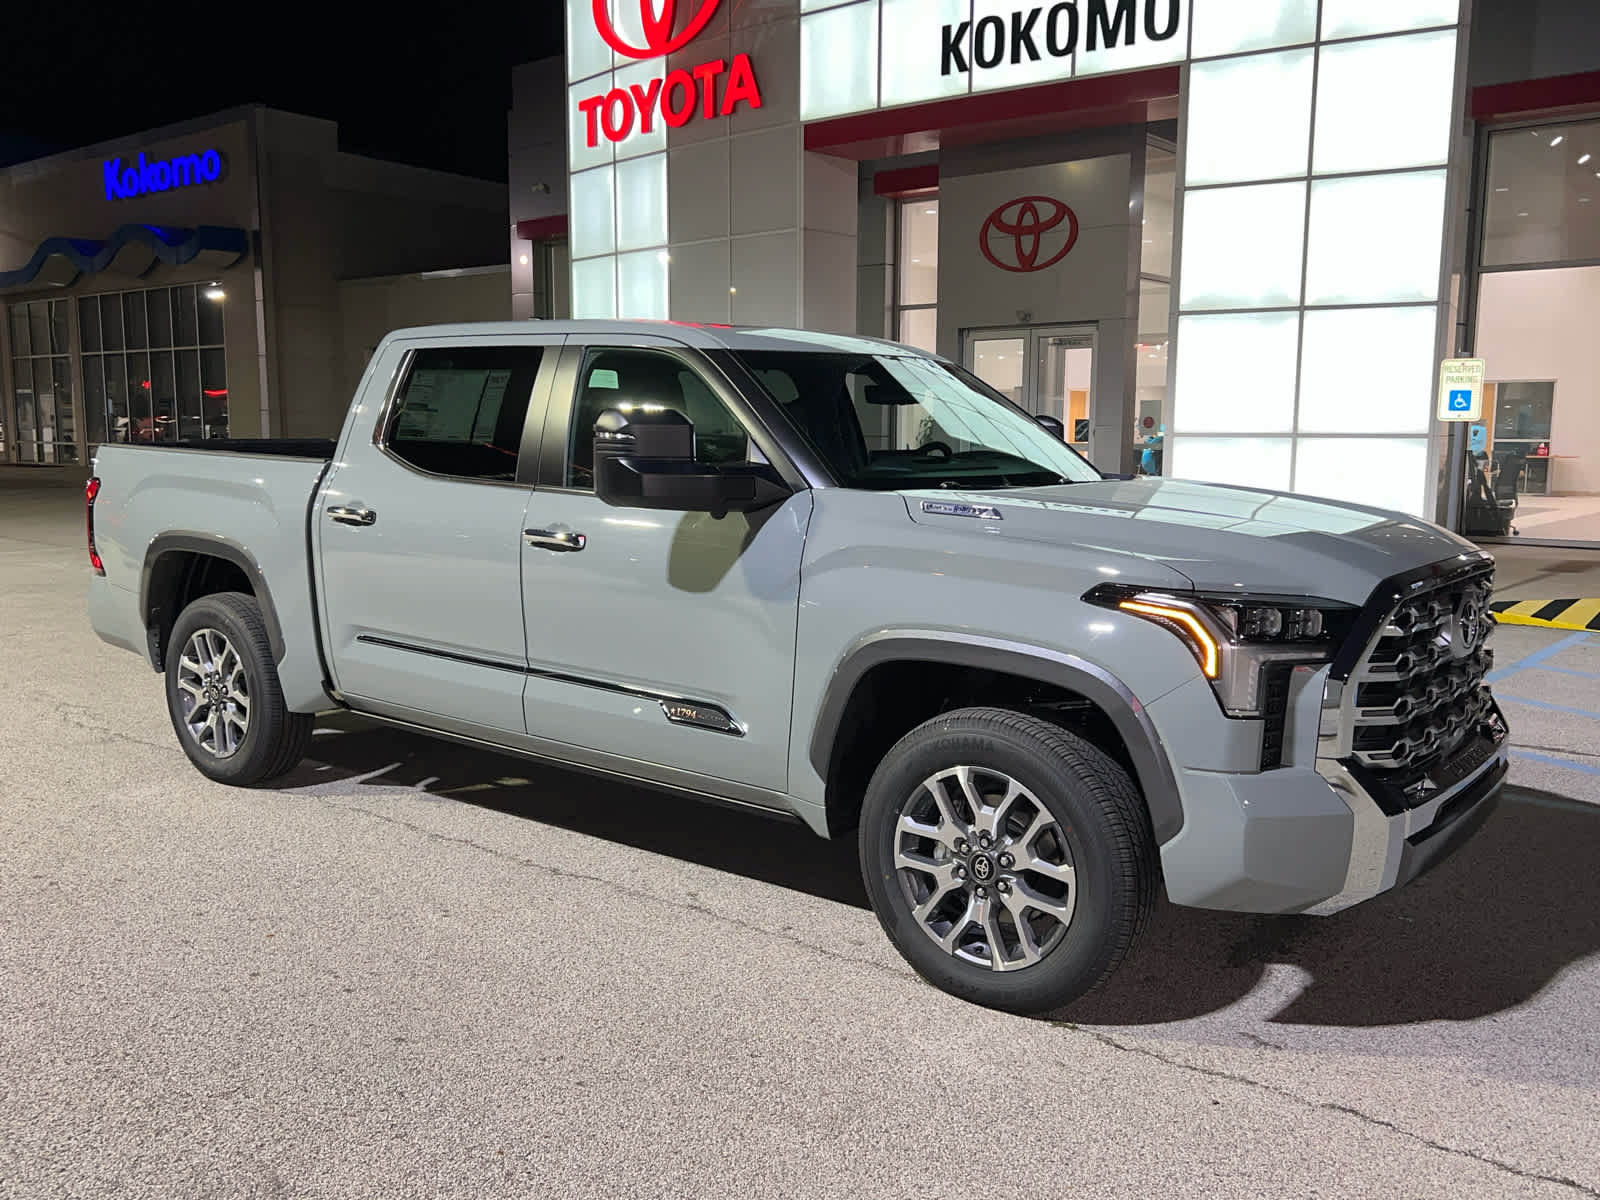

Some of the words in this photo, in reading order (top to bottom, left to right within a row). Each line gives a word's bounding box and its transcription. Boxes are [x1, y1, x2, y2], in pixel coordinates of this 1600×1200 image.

[941, 0, 1180, 76] KOKOMO
[578, 53, 763, 148] TOYOTA
[103, 149, 221, 201] Kokomo
[676, 707, 698, 719] 1794
